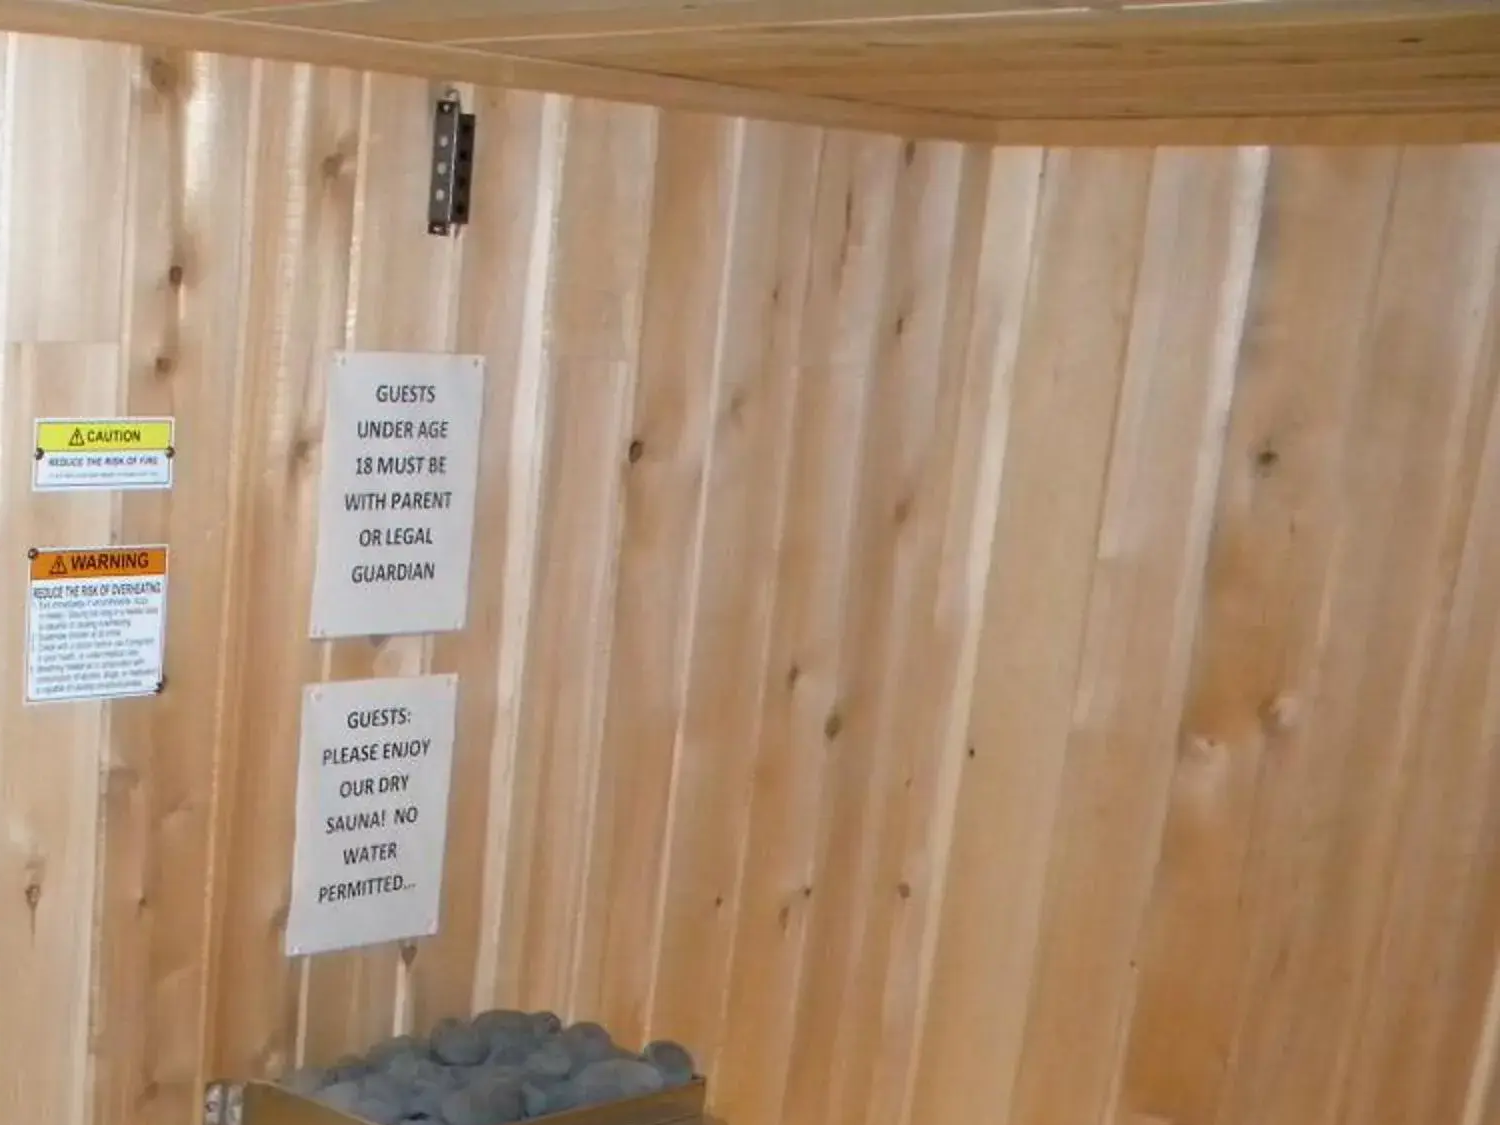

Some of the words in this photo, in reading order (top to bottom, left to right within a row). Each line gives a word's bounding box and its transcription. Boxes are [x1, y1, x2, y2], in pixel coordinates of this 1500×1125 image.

[375, 384, 436, 403] GUESTS
[87, 429, 141, 442] CAUTION
[357, 420, 413, 439] UNDER
[417, 421, 449, 438] AGE
[86, 457, 101, 466] THE
[104, 456, 124, 466] RISK
[126, 455, 137, 465] OF
[356, 457, 373, 475] 18
[377, 456, 424, 475] MUST
[428, 456, 447, 474] BE
[344, 492, 386, 512] WITH
[391, 491, 452, 511] PARENT
[358, 529, 382, 547] OR
[386, 527, 433, 546] LEGAL
[71, 552, 149, 571] WARNING
[351, 562, 436, 584] GUARDIAN
[65, 586, 80, 597] THE
[81, 585, 100, 597] RISK
[100, 584, 110, 596] OF
[347, 707, 412, 730] GUESTS:
[322, 743, 378, 766] PLEASE
[383, 738, 431, 760] ENJOY
[339, 778, 374, 799] OUR
[379, 775, 410, 794] DRY
[325, 810, 386, 834] SAUNA!
[393, 806, 418, 825] NO
[343, 842, 398, 866] WATER
